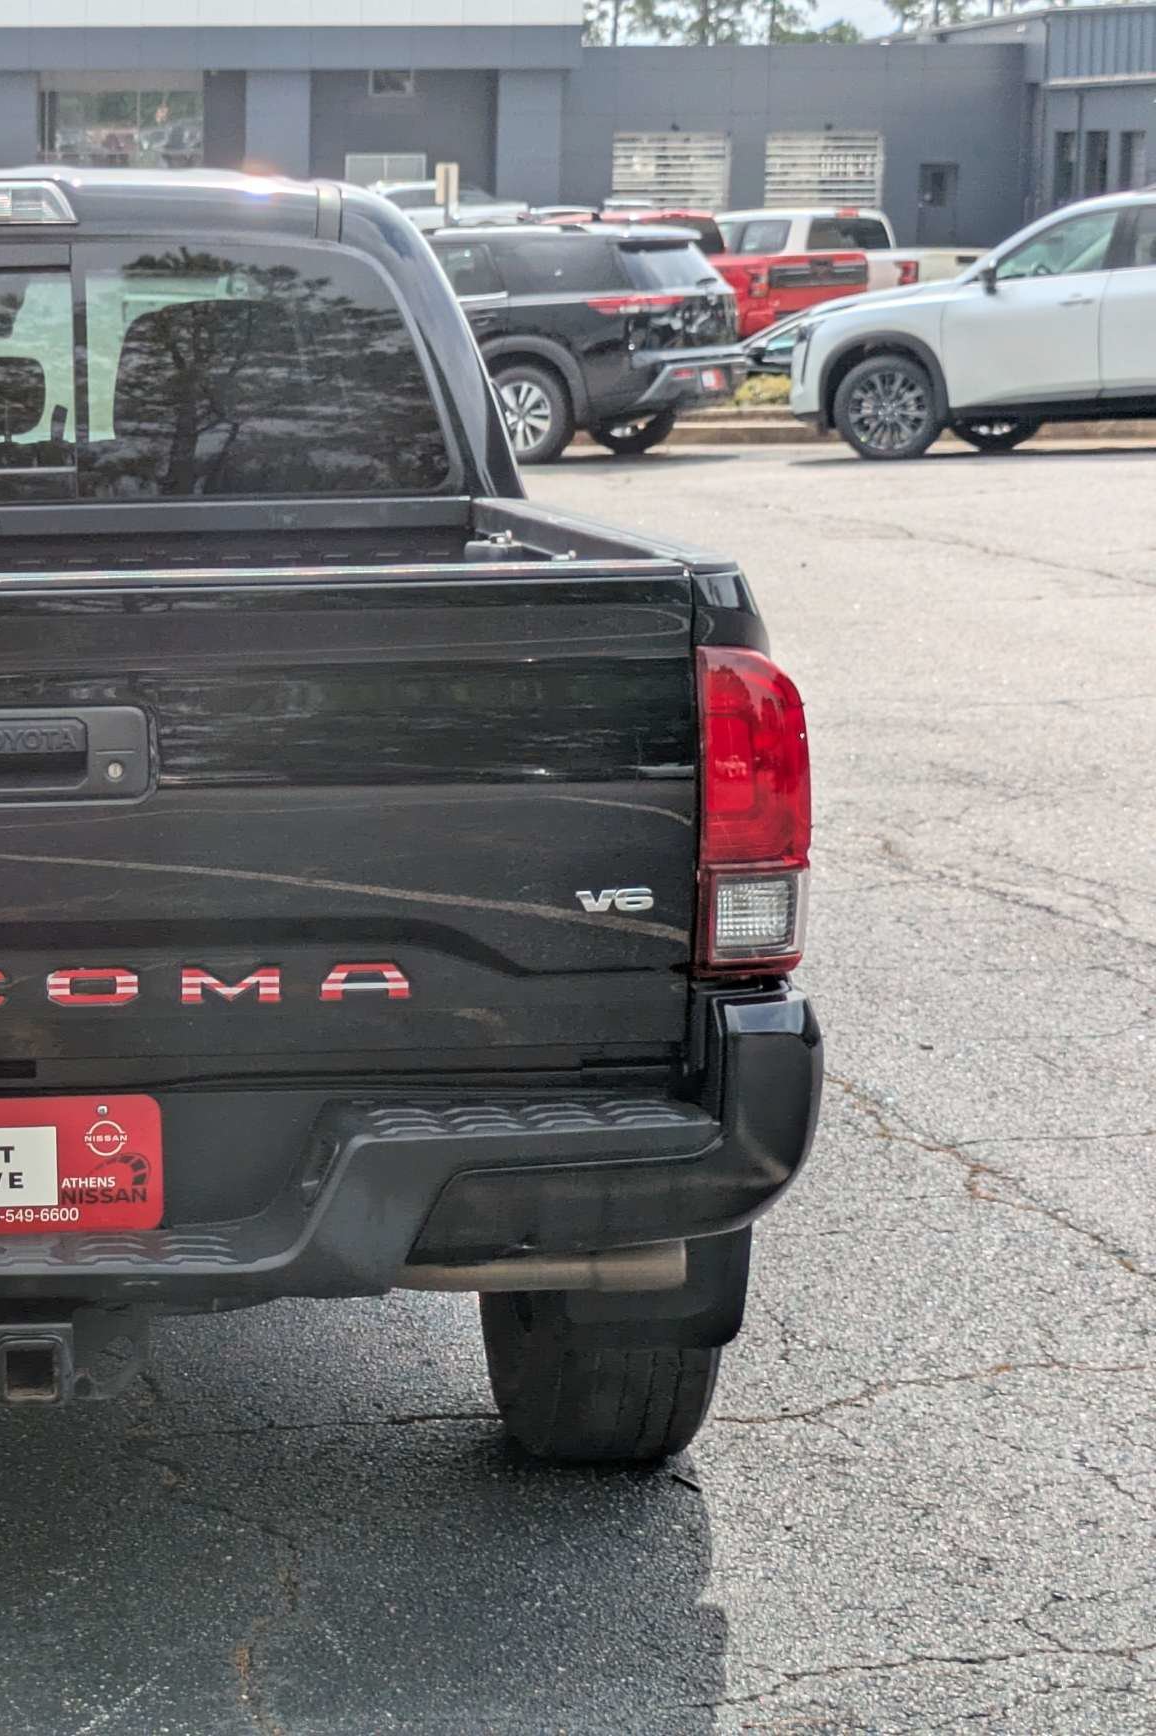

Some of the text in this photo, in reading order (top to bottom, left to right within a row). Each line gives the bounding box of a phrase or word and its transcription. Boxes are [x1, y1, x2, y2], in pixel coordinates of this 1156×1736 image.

[575, 887, 654, 912] V6
[84, 1133, 128, 1143] NISSAN
[61, 1176, 116, 1190] ATHENS
[61, 1187, 148, 1206] NISSAN
